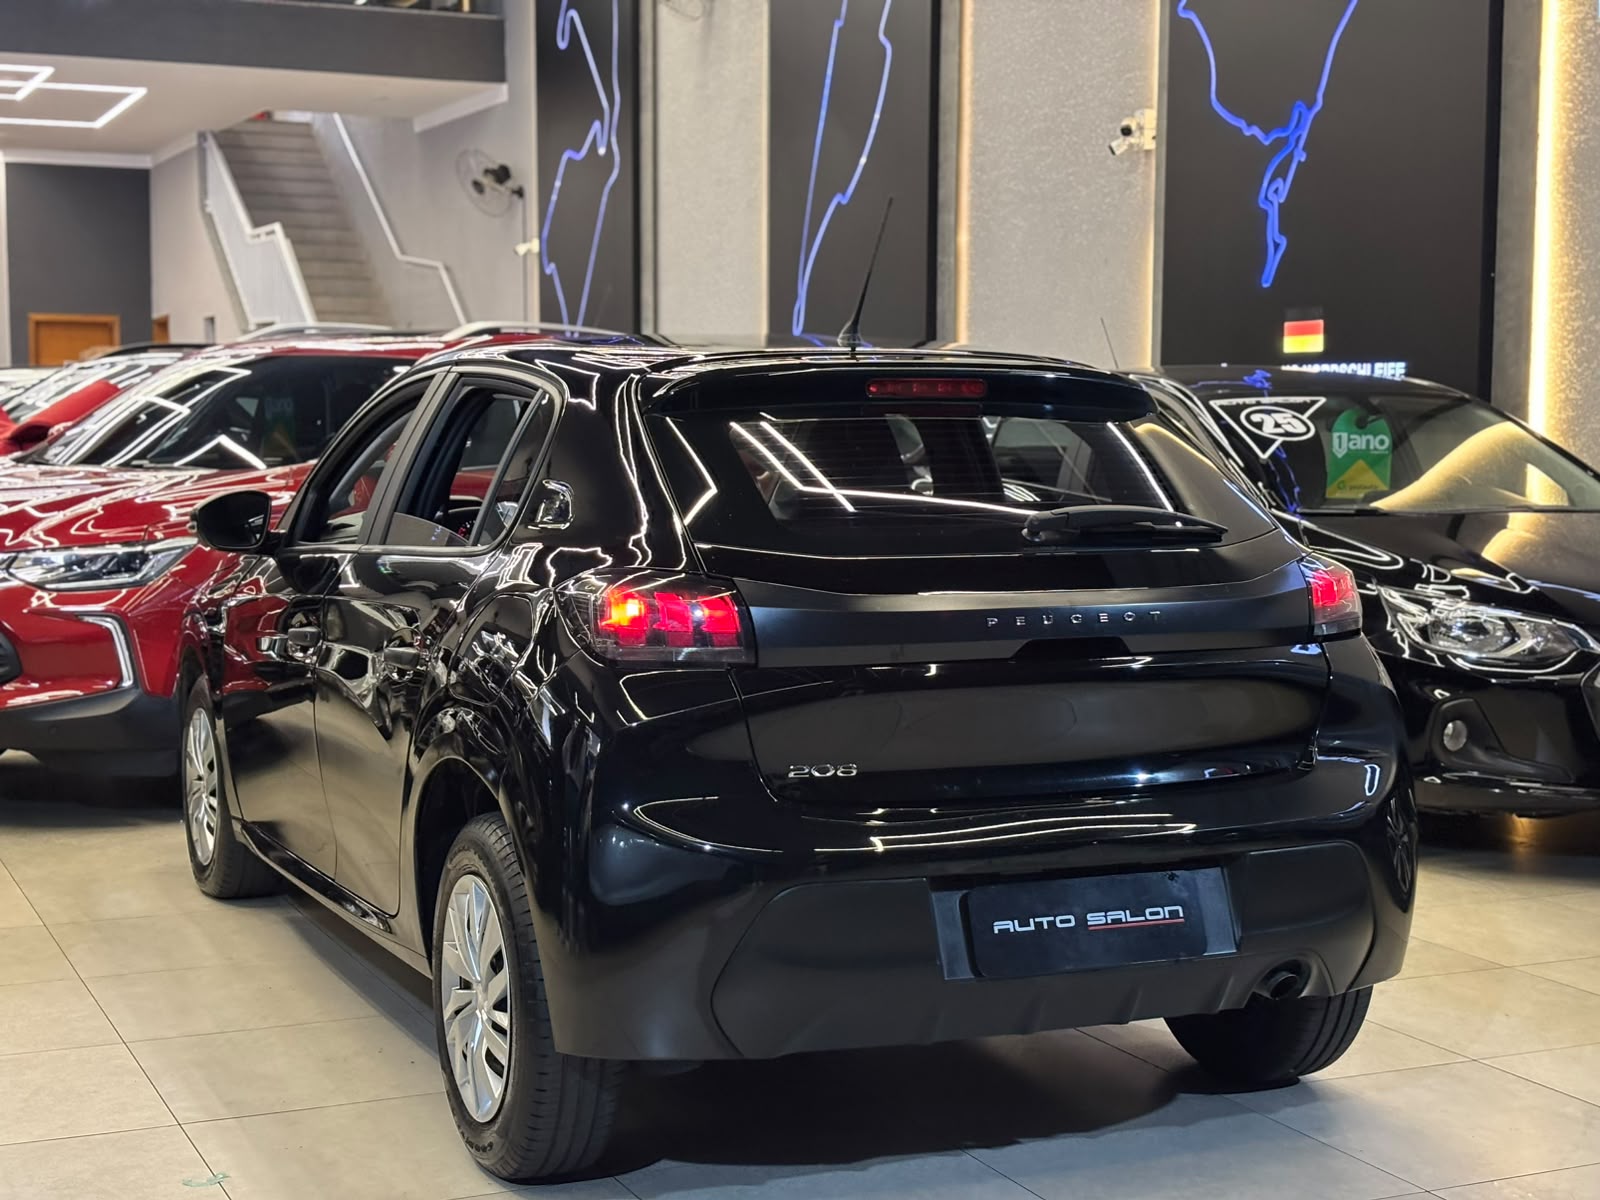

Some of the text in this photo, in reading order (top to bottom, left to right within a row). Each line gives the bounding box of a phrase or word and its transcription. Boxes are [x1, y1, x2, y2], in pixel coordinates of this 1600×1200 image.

[1250, 412, 1307, 434] 25
[986, 610, 1161, 627] PEUGEOT
[788, 763, 858, 778] 208
[992, 904, 1185, 934] AUTO SALON
